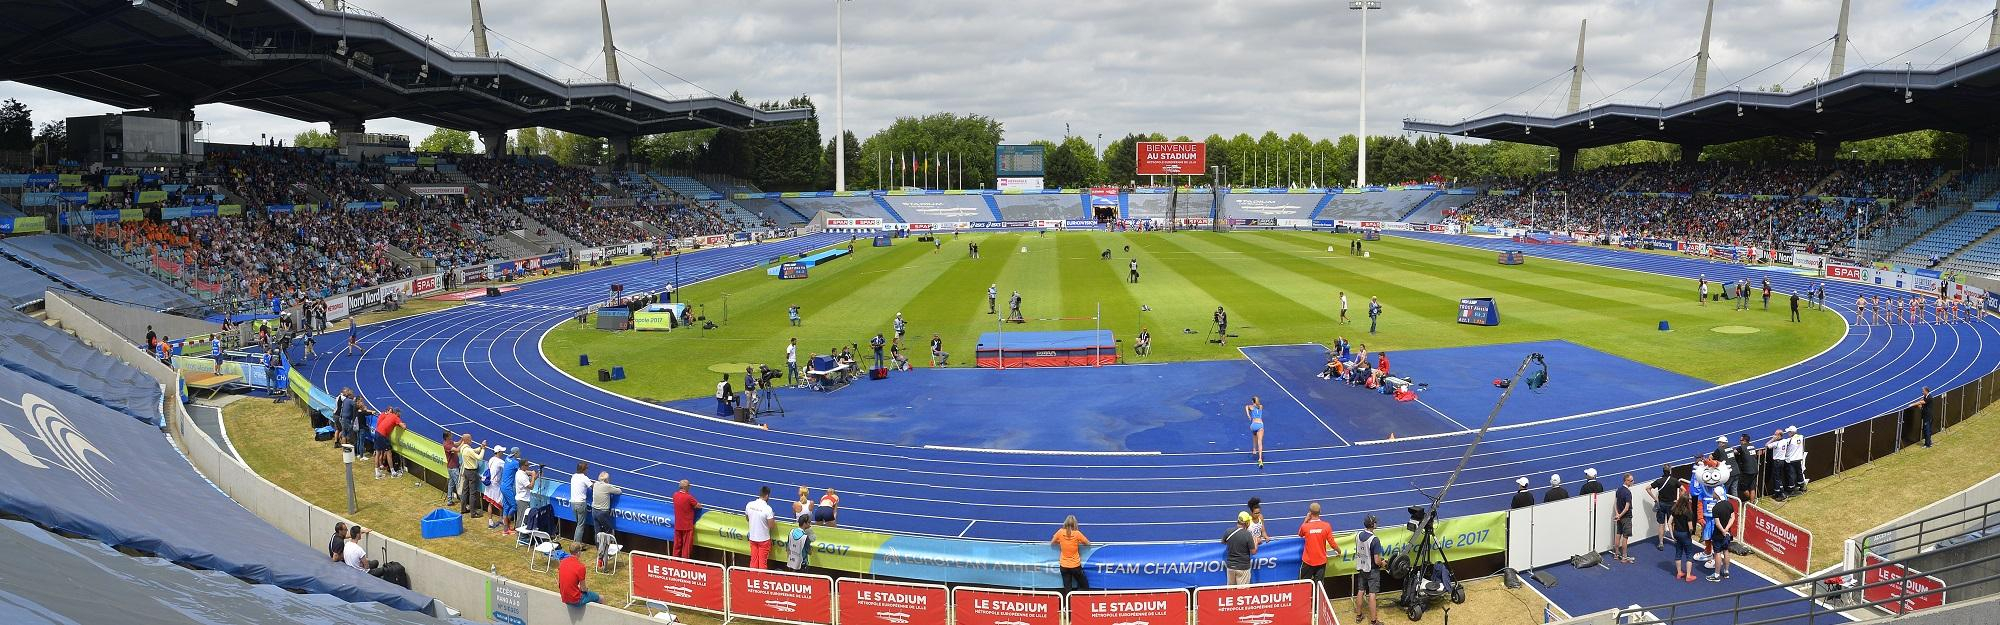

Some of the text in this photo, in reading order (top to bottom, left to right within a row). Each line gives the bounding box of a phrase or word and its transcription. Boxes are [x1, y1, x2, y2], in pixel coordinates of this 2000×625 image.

[1779, 252, 1792, 262] Nord
[1834, 267, 1860, 279] SPAR
[417, 278, 435, 290] SPAR
[349, 289, 380, 309] Nord Nord
[719, 528, 743, 540] Lille
[1756, 516, 1798, 543] LE STADIUM
[1457, 529, 1490, 547] 2017
[817, 542, 850, 556] 2017
[904, 553, 987, 572] EUROPEAN
[1095, 562, 1140, 575] TEAM
[647, 564, 707, 581] LE STADIUM
[1878, 568, 1889, 580] LE
[747, 579, 812, 594] LE STADIUM
[857, 590, 927, 605] LE STADIUM
[1218, 592, 1292, 607] LE STADIUM
[974, 599, 1048, 613] LE STADIUM
[1091, 601, 1166, 612] LE STADIUM
